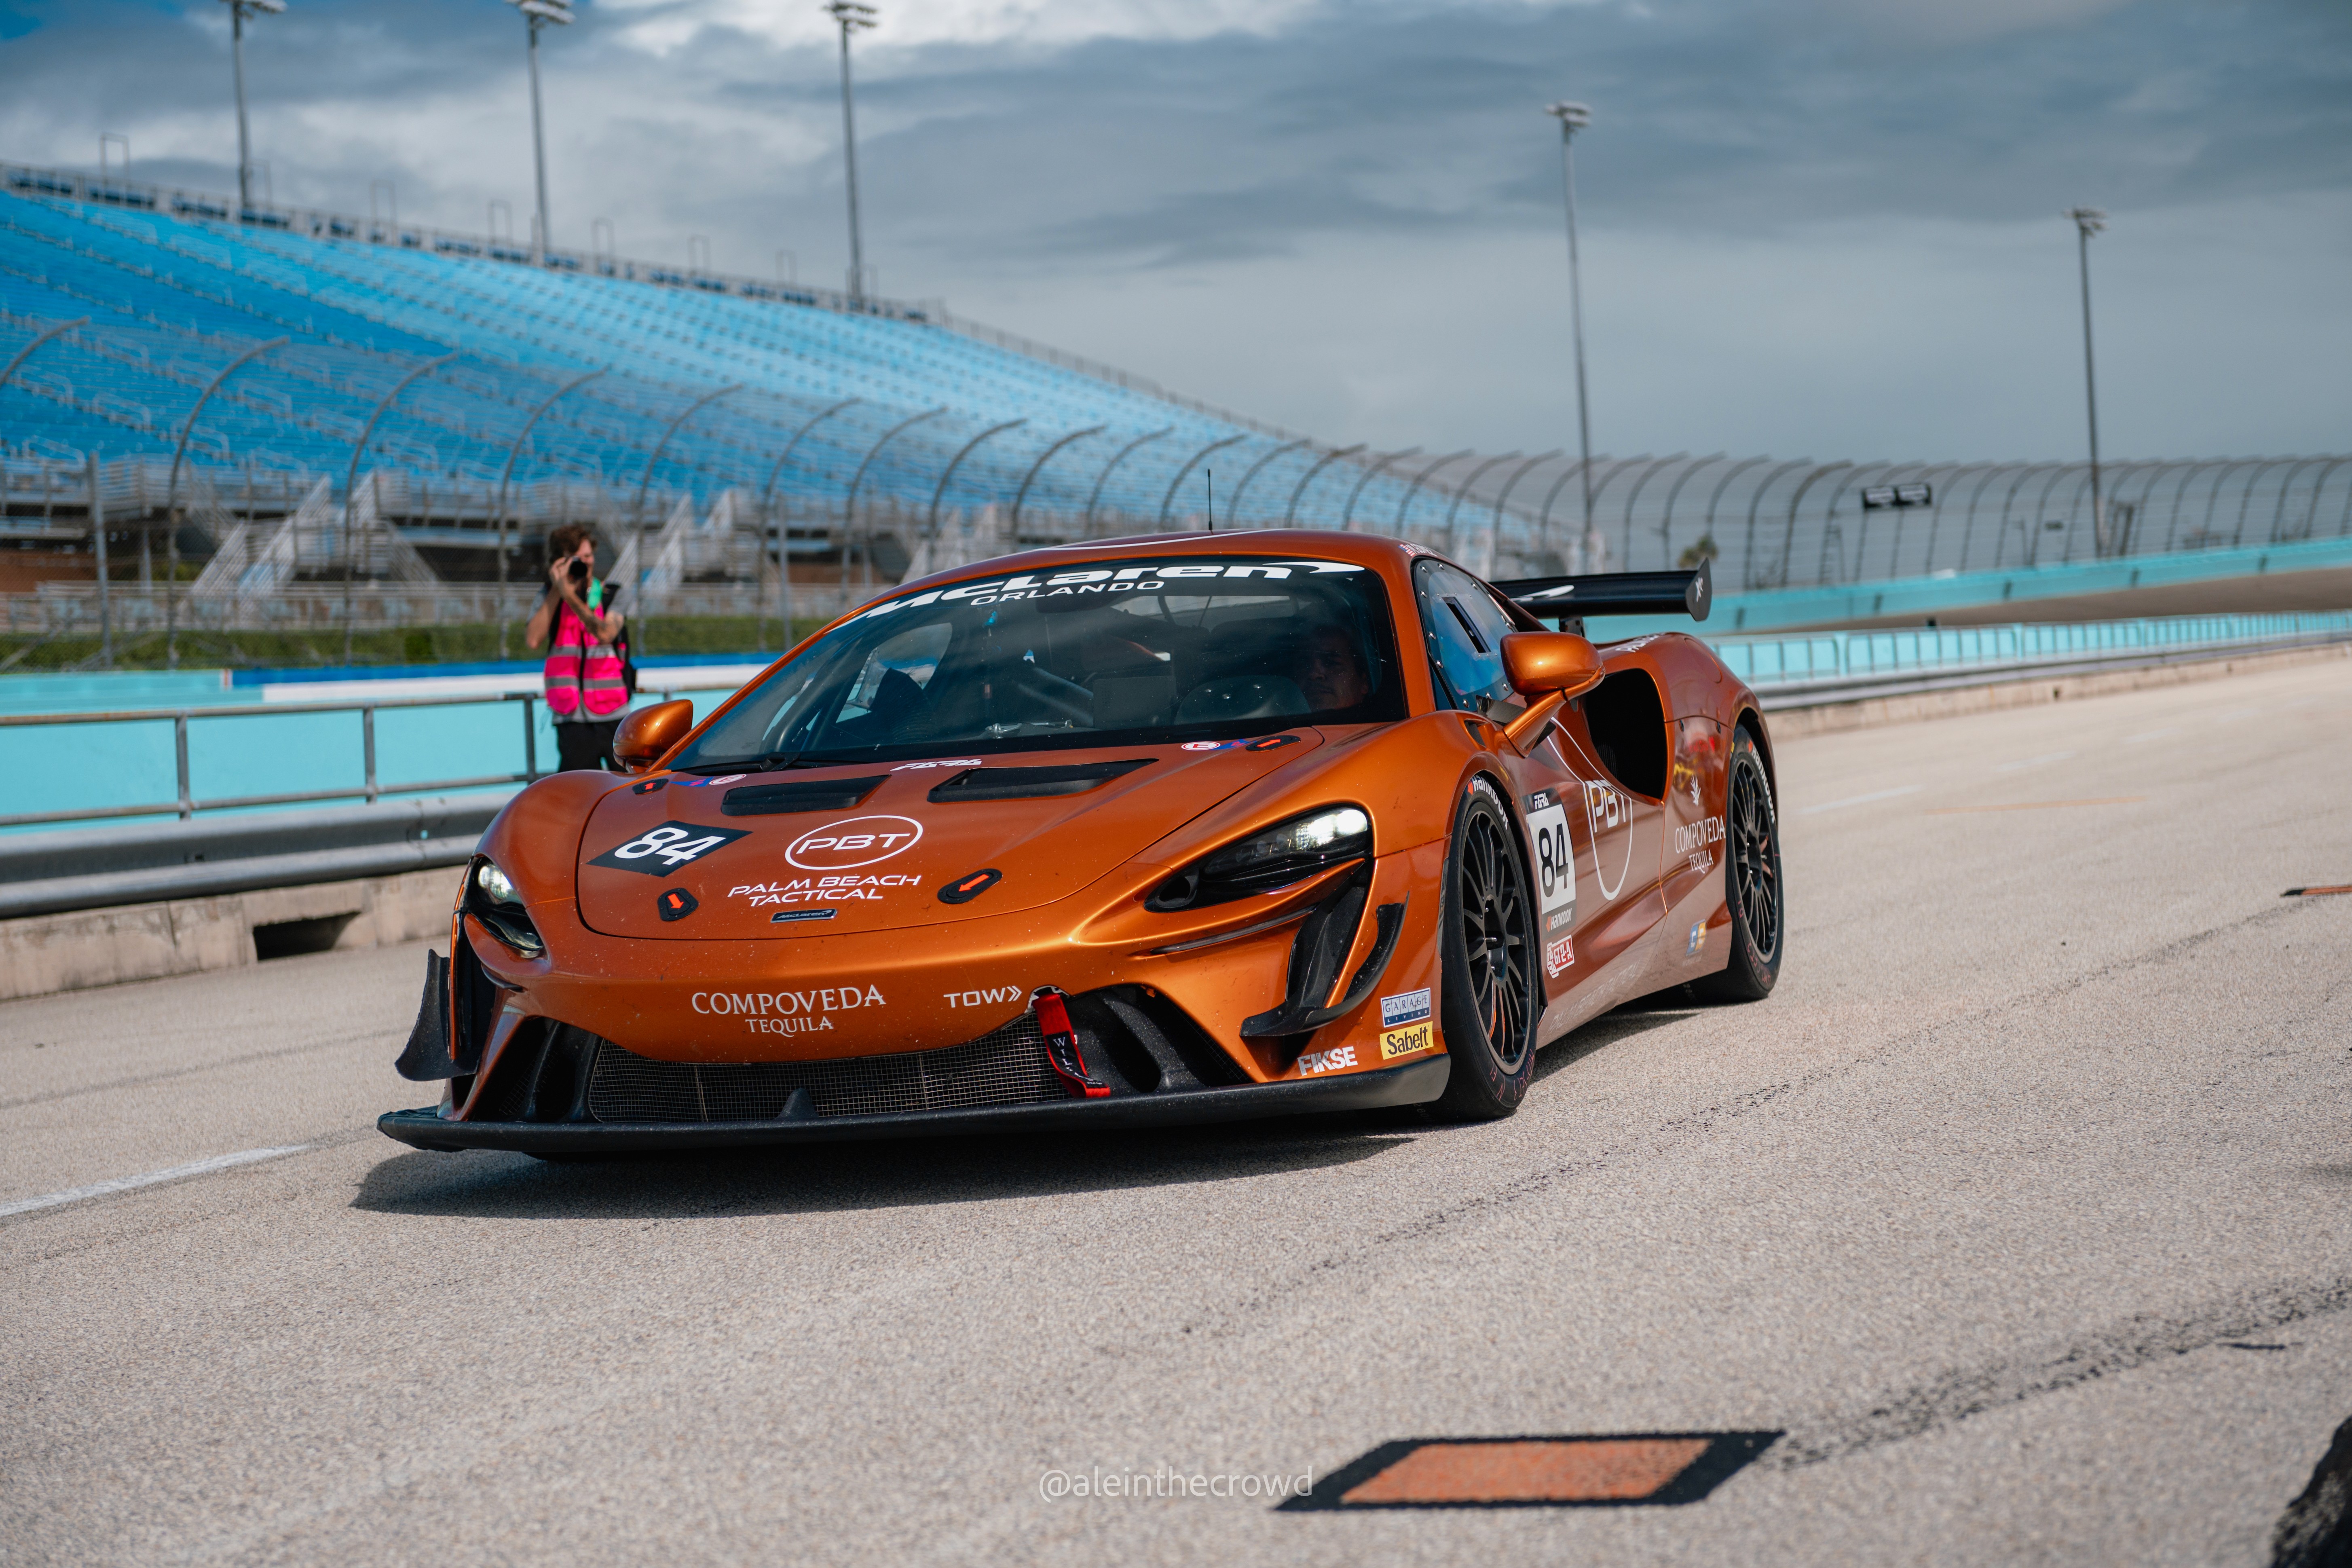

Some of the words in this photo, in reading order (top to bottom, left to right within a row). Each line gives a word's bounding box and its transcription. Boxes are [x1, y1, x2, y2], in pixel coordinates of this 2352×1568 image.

[970, 581, 1165, 606] ORLANDO
[1585, 780, 1626, 833] PBT
[614, 826, 726, 866] 84
[796, 833, 911, 855] PBT
[1675, 814, 1726, 854] COMPOVEDA
[1538, 823, 1569, 898] 84
[1689, 849, 1714, 874] TEQUILA
[727, 878, 809, 898] PALM
[817, 875, 922, 888] BEACH
[749, 889, 883, 907] TACTICAL
[776, 911, 829, 919] McLaren
[691, 984, 886, 1016] COMPOVEDA
[943, 987, 1006, 1008] TOW
[1385, 995, 1427, 1013] GARAGE
[745, 1015, 834, 1038] TEQUILA
[1387, 1009, 1428, 1023] LIVING
[1386, 1026, 1429, 1055] Sabelt
[1297, 1046, 1358, 1076] FIKSE
